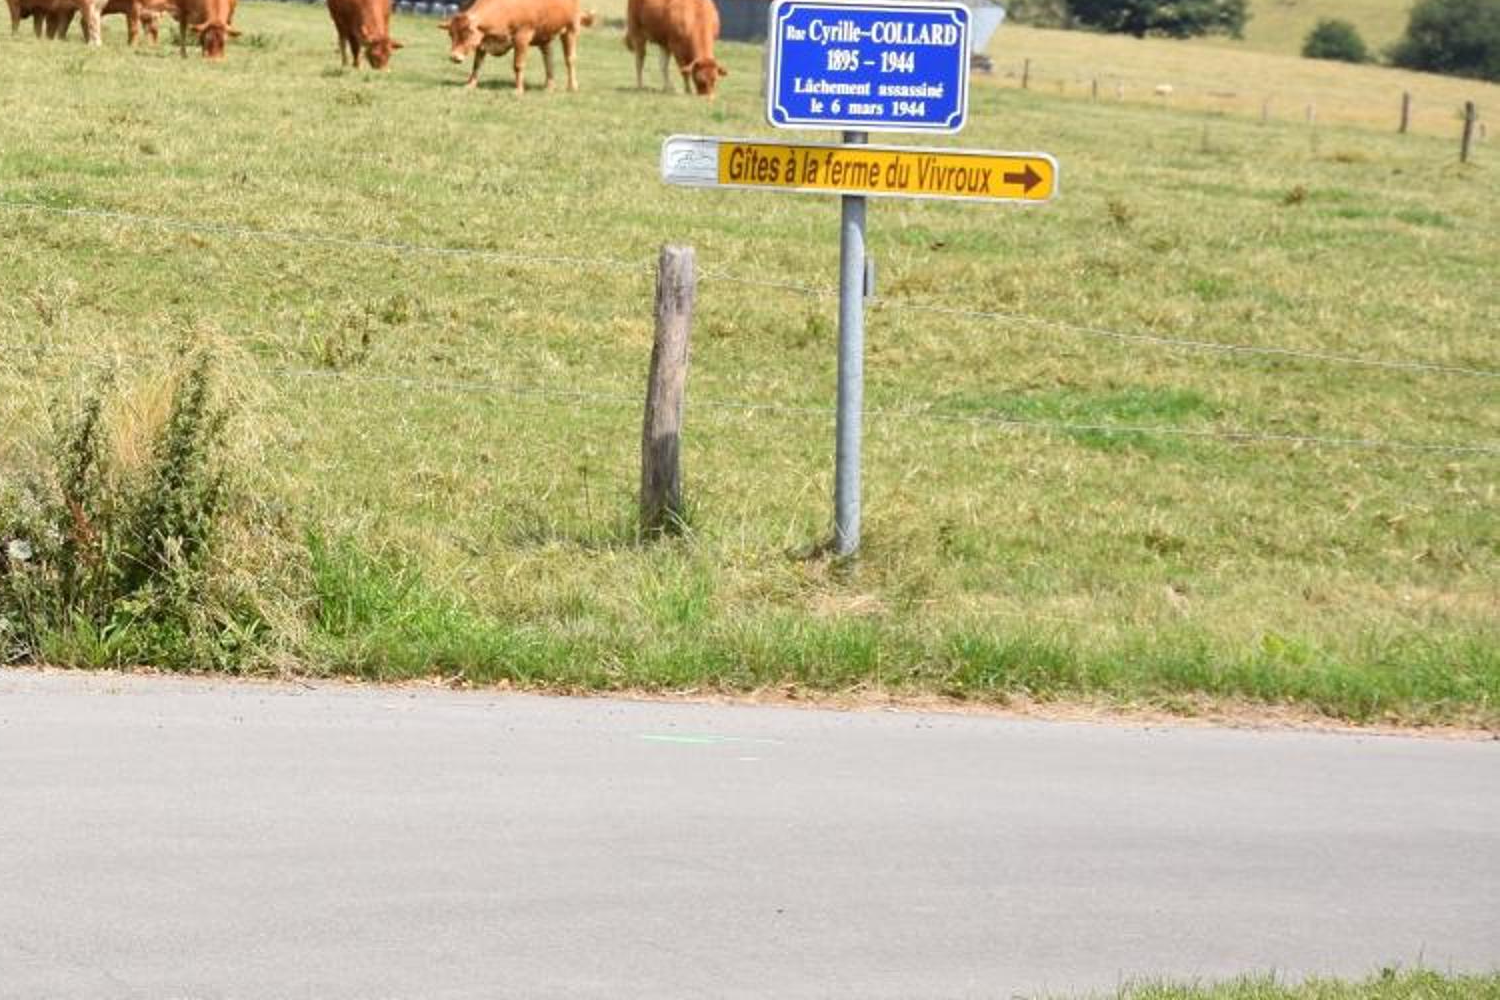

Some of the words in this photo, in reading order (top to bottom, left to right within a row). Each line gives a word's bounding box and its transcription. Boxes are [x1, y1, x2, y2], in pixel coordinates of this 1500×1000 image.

[809, 19, 958, 46] Cyrille-COLLARD
[827, 49, 859, 72] 1895
[880, 51, 915, 73] 1944
[794, 78, 871, 96] Lâchement
[878, 82, 944, 99] assassiné
[811, 98, 823, 113] le
[831, 99, 841, 114] 6
[848, 102, 884, 115] mars
[892, 101, 925, 117] 1944
[729, 147, 780, 183] Gîtes
[784, 151, 797, 183] à
[801, 152, 818, 184] la
[824, 152, 880, 188] ferme
[885, 156, 910, 190] du
[917, 157, 993, 193] Vivroux
